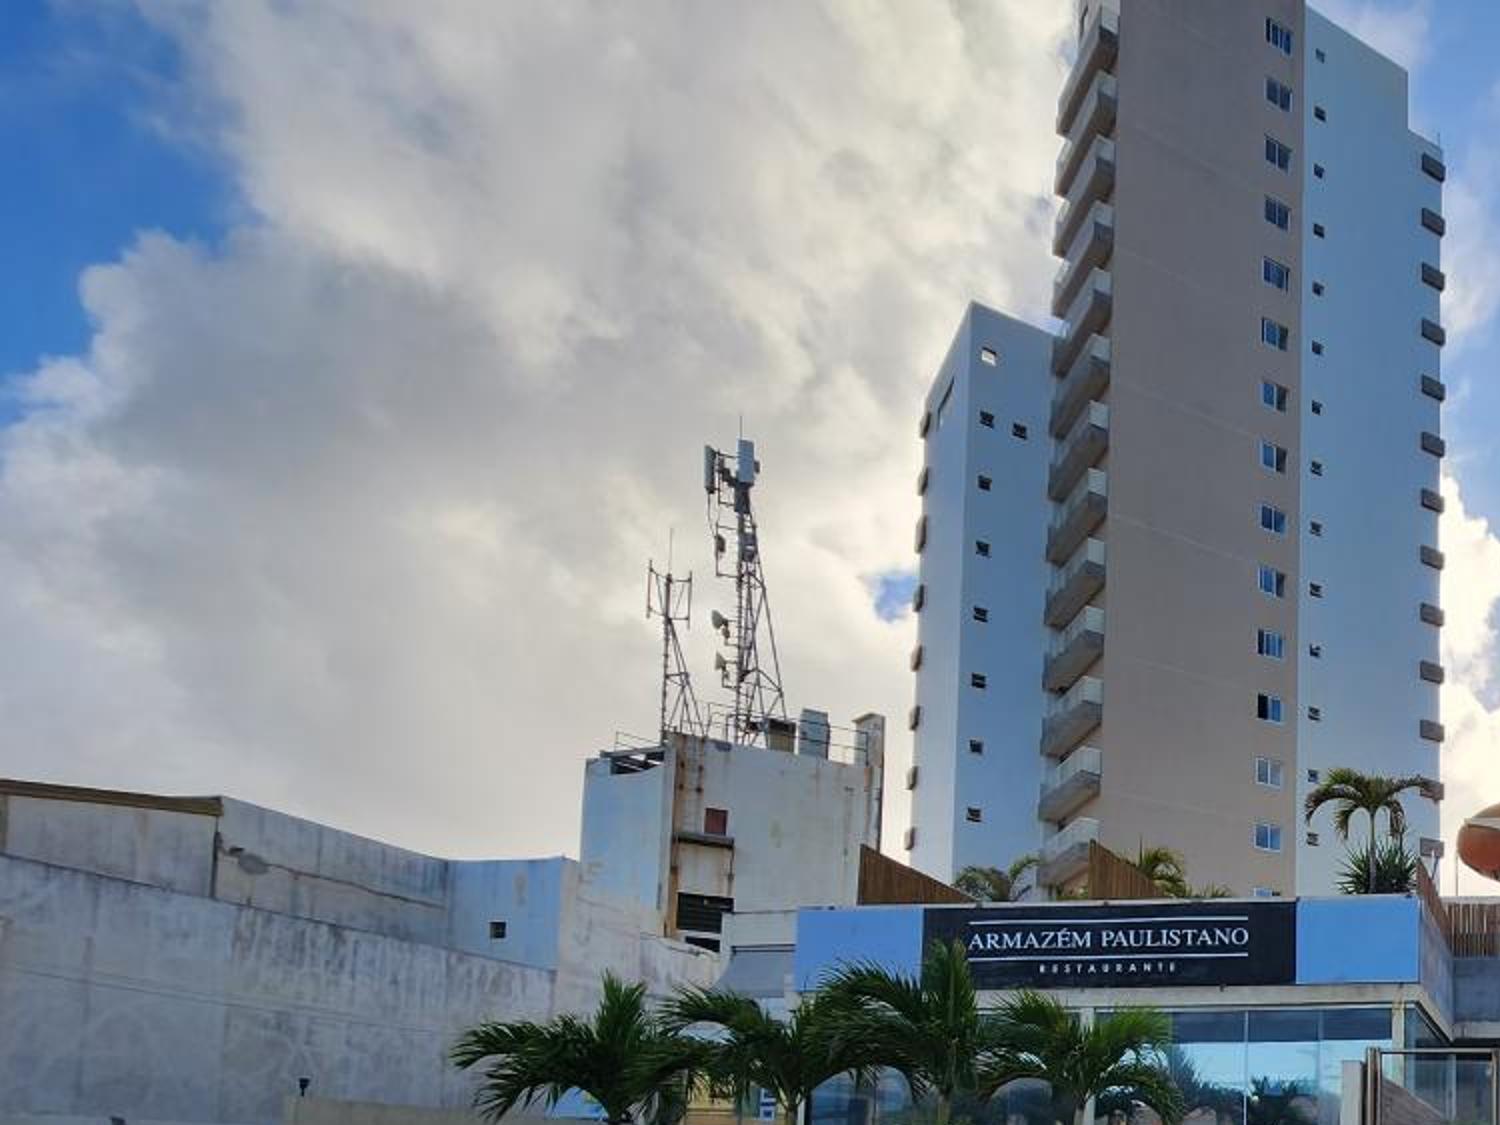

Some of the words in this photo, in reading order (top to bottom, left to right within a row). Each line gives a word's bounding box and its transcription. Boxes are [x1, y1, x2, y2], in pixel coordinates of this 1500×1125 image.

[969, 928, 1091, 949] ARMAZÉM
[1101, 928, 1248, 947] PAULISTANO
[1039, 961, 1176, 973] RESTAURANTE
